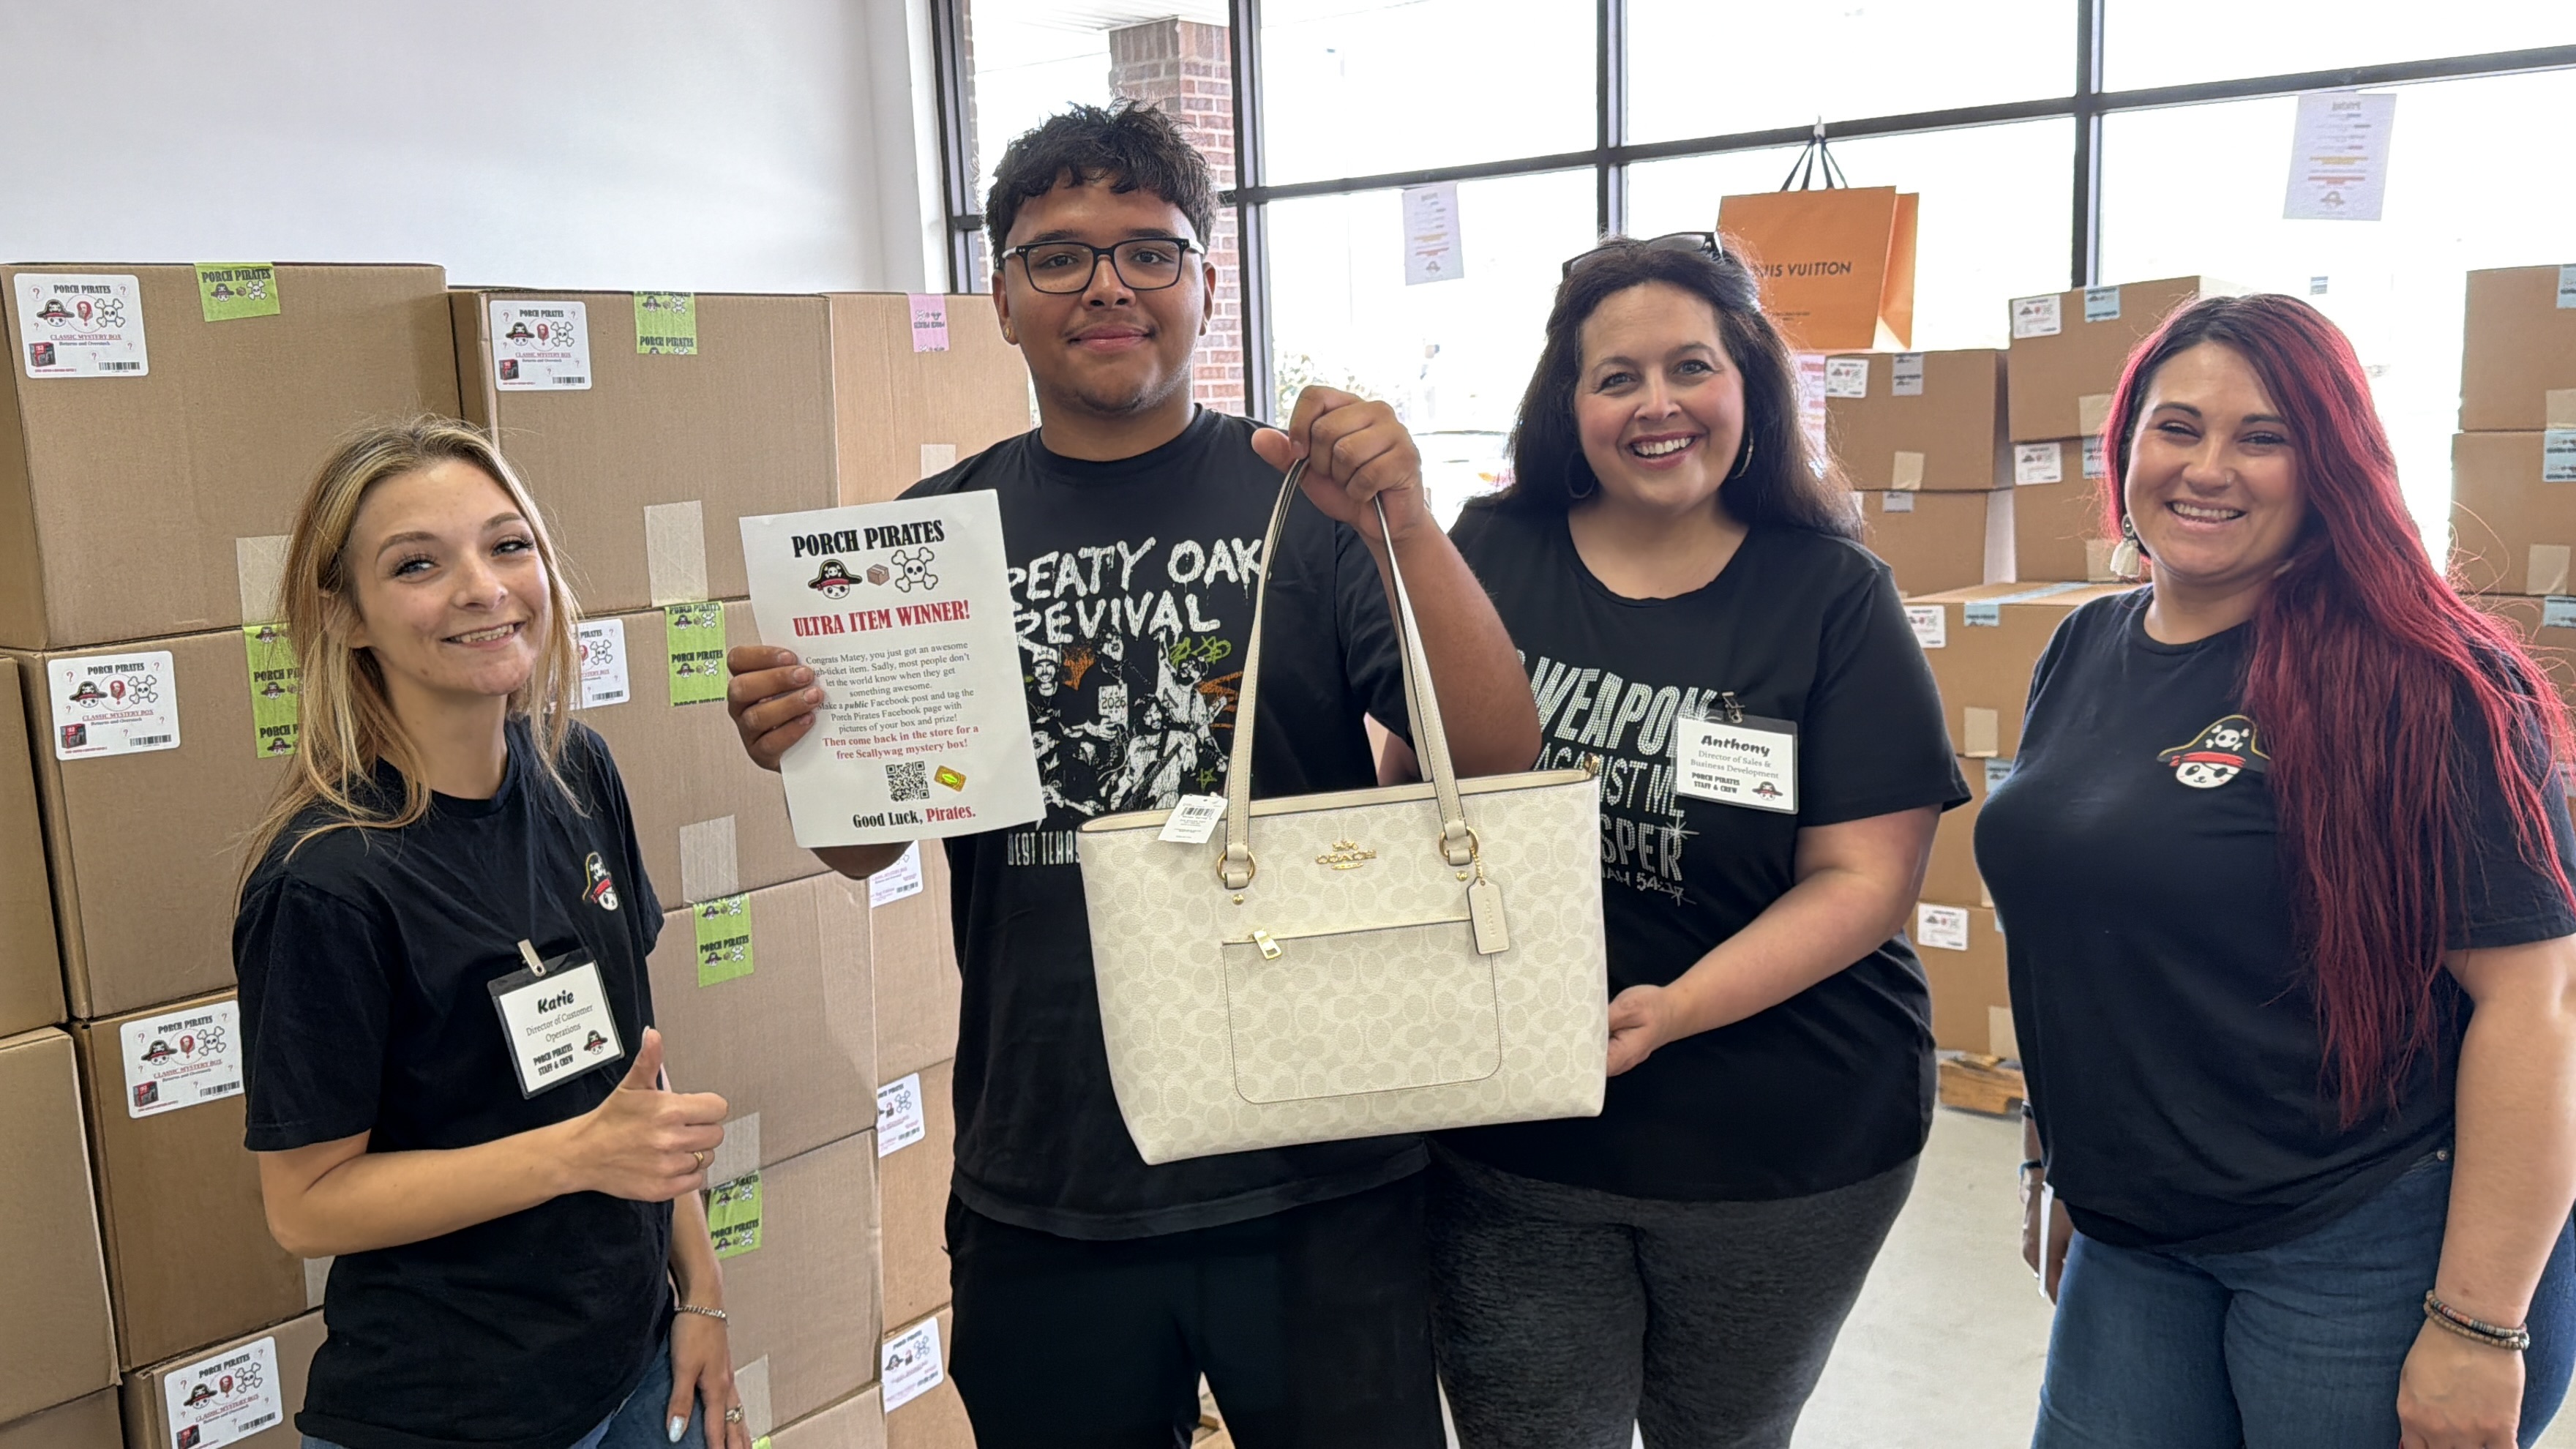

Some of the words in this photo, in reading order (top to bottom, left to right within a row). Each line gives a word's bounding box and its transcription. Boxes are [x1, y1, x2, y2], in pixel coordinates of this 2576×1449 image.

[201, 271, 233, 282] PORCH
[234, 268, 271, 281] PIRATES
[1788, 261, 1852, 276] VUITTON
[53, 285, 79, 293] PORCH
[81, 285, 111, 294] PIRATES
[520, 309, 539, 318] PORCH
[541, 310, 564, 318] PIRATES
[640, 336, 664, 345] PORCH
[666, 337, 694, 347] PIRATES
[791, 529, 861, 558] PORCH
[864, 520, 945, 550] PIRATES
[1168, 537, 1265, 589] OAK
[792, 614, 845, 637] ULTRA
[849, 609, 893, 633] ITEM
[896, 599, 970, 626] WINNER!
[580, 629, 602, 638] PIRATES
[671, 653, 695, 663] PORCH
[697, 650, 723, 660] PIRATES
[805, 656, 839, 665] Congrats
[840, 654, 868, 663] Matey,
[869, 652, 885, 662] you
[887, 650, 902, 658] just
[905, 648, 916, 657] got
[931, 643, 968, 652] awesome
[88, 665, 113, 675] PORCH
[116, 663, 145, 673] PIRATES
[812, 667, 847, 677] igh-ticket
[849, 666, 869, 675] item.
[871, 662, 897, 671] Sadly,
[899, 660, 918, 668] most
[921, 656, 947, 667] people
[949, 653, 970, 662] don't
[253, 669, 285, 682] PORCH
[850, 676, 873, 685] world
[875, 675, 897, 683] know
[899, 671, 921, 680] when
[924, 669, 940, 678] they
[943, 667, 956, 677] get
[850, 687, 891, 697] something
[893, 682, 932, 692] awesome.
[845, 701, 869, 711] public
[870, 695, 910, 707] Facebook
[912, 694, 928, 705] post
[931, 691, 946, 700] and
[947, 692, 960, 700] tag
[962, 689, 974, 697] the
[1101, 697, 1126, 710] 2026
[831, 713, 853, 721] Porch
[853, 712, 880, 720] Pirates
[882, 706, 921, 718] Facebook
[924, 705, 942, 715] page
[944, 702, 962, 710] with
[260, 724, 291, 738] PORCH
[839, 724, 867, 735] pictures
[880, 722, 898, 731] your
[900, 719, 916, 727] box
[918, 716, 932, 725] and
[935, 714, 957, 725] prize!
[823, 737, 846, 746] Then
[849, 737, 871, 745] come
[874, 733, 898, 744] back
[899, 732, 910, 741] in
[913, 730, 928, 739] the
[929, 729, 954, 738] store
[956, 725, 970, 735] for
[836, 750, 855, 760] free
[856, 748, 904, 760] Scallywag
[906, 743, 944, 755] mystery
[947, 738, 968, 749] box!
[1701, 735, 1770, 757] Anthony
[1699, 750, 1731, 763] Director
[1733, 755, 1741, 763] of
[1742, 758, 1762, 767] Sales
[1533, 741, 1648, 809] AGANST
[1690, 759, 1724, 771] Business
[1727, 765, 1778, 779] Development
[1692, 772, 1712, 781] PORCH
[1715, 776, 1740, 786] PIRATES
[1693, 780, 1711, 790] STAFF
[1720, 786, 1737, 794] CREW
[853, 812, 886, 828] Good
[888, 809, 923, 825] Luck,
[926, 806, 976, 823] Pirates.
[1315, 850, 1377, 865] COACH
[537, 989, 574, 1014] Katie
[158, 1022, 182, 1034] PORCH
[184, 1015, 213, 1029] PIRATES
[525, 1019, 553, 1036] Director
[554, 1013, 562, 1025] of
[562, 1004, 594, 1022] Customer
[546, 1023, 581, 1043] Operations
[533, 1051, 552, 1066] PORCH
[552, 1043, 574, 1060] PIRATES
[538, 1064, 554, 1076] STAFF
[560, 1055, 574, 1067] CREW
[199, 1364, 222, 1379] PORCH
[223, 1354, 250, 1369] PIRATES
